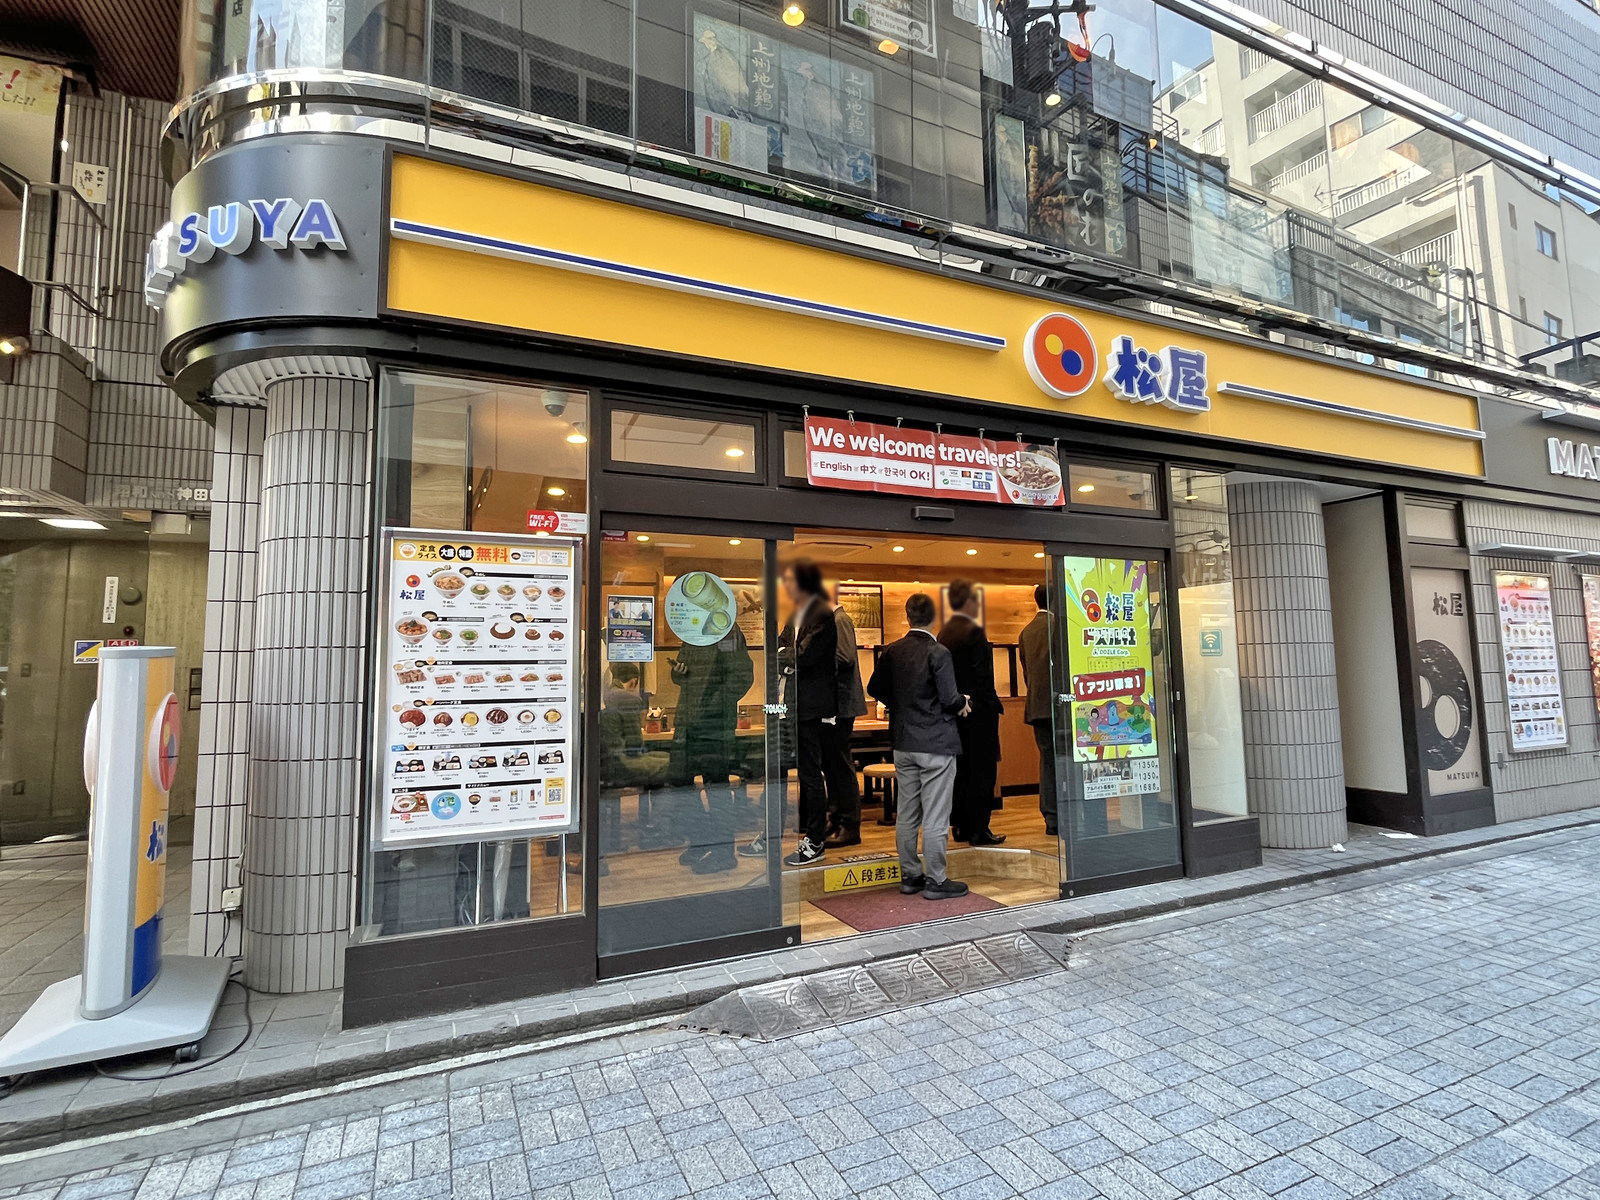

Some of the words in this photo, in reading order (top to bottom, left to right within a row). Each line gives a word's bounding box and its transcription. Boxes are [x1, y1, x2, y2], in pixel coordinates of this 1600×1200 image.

[1110, 336, 1210, 412] 松屋
[808, 425, 845, 448] We
[849, 433, 935, 460] welcome
[940, 443, 1021, 468] travelers!
[819, 460, 853, 473] English
[860, 464, 877, 475] 中文
[884, 466, 907, 478] 한국어
[909, 469, 930, 481] OK!
[529, 519, 554, 528] Wi-Fi
[419, 544, 436, 553] 定食
[417, 552, 438, 560] ライス
[476, 546, 508, 563] 無料
[400, 589, 425, 600] 松屋
[1432, 592, 1464, 617] 松屋
[764, 703, 788, 714] TOUCH
[1446, 771, 1480, 781] MATSUYA
